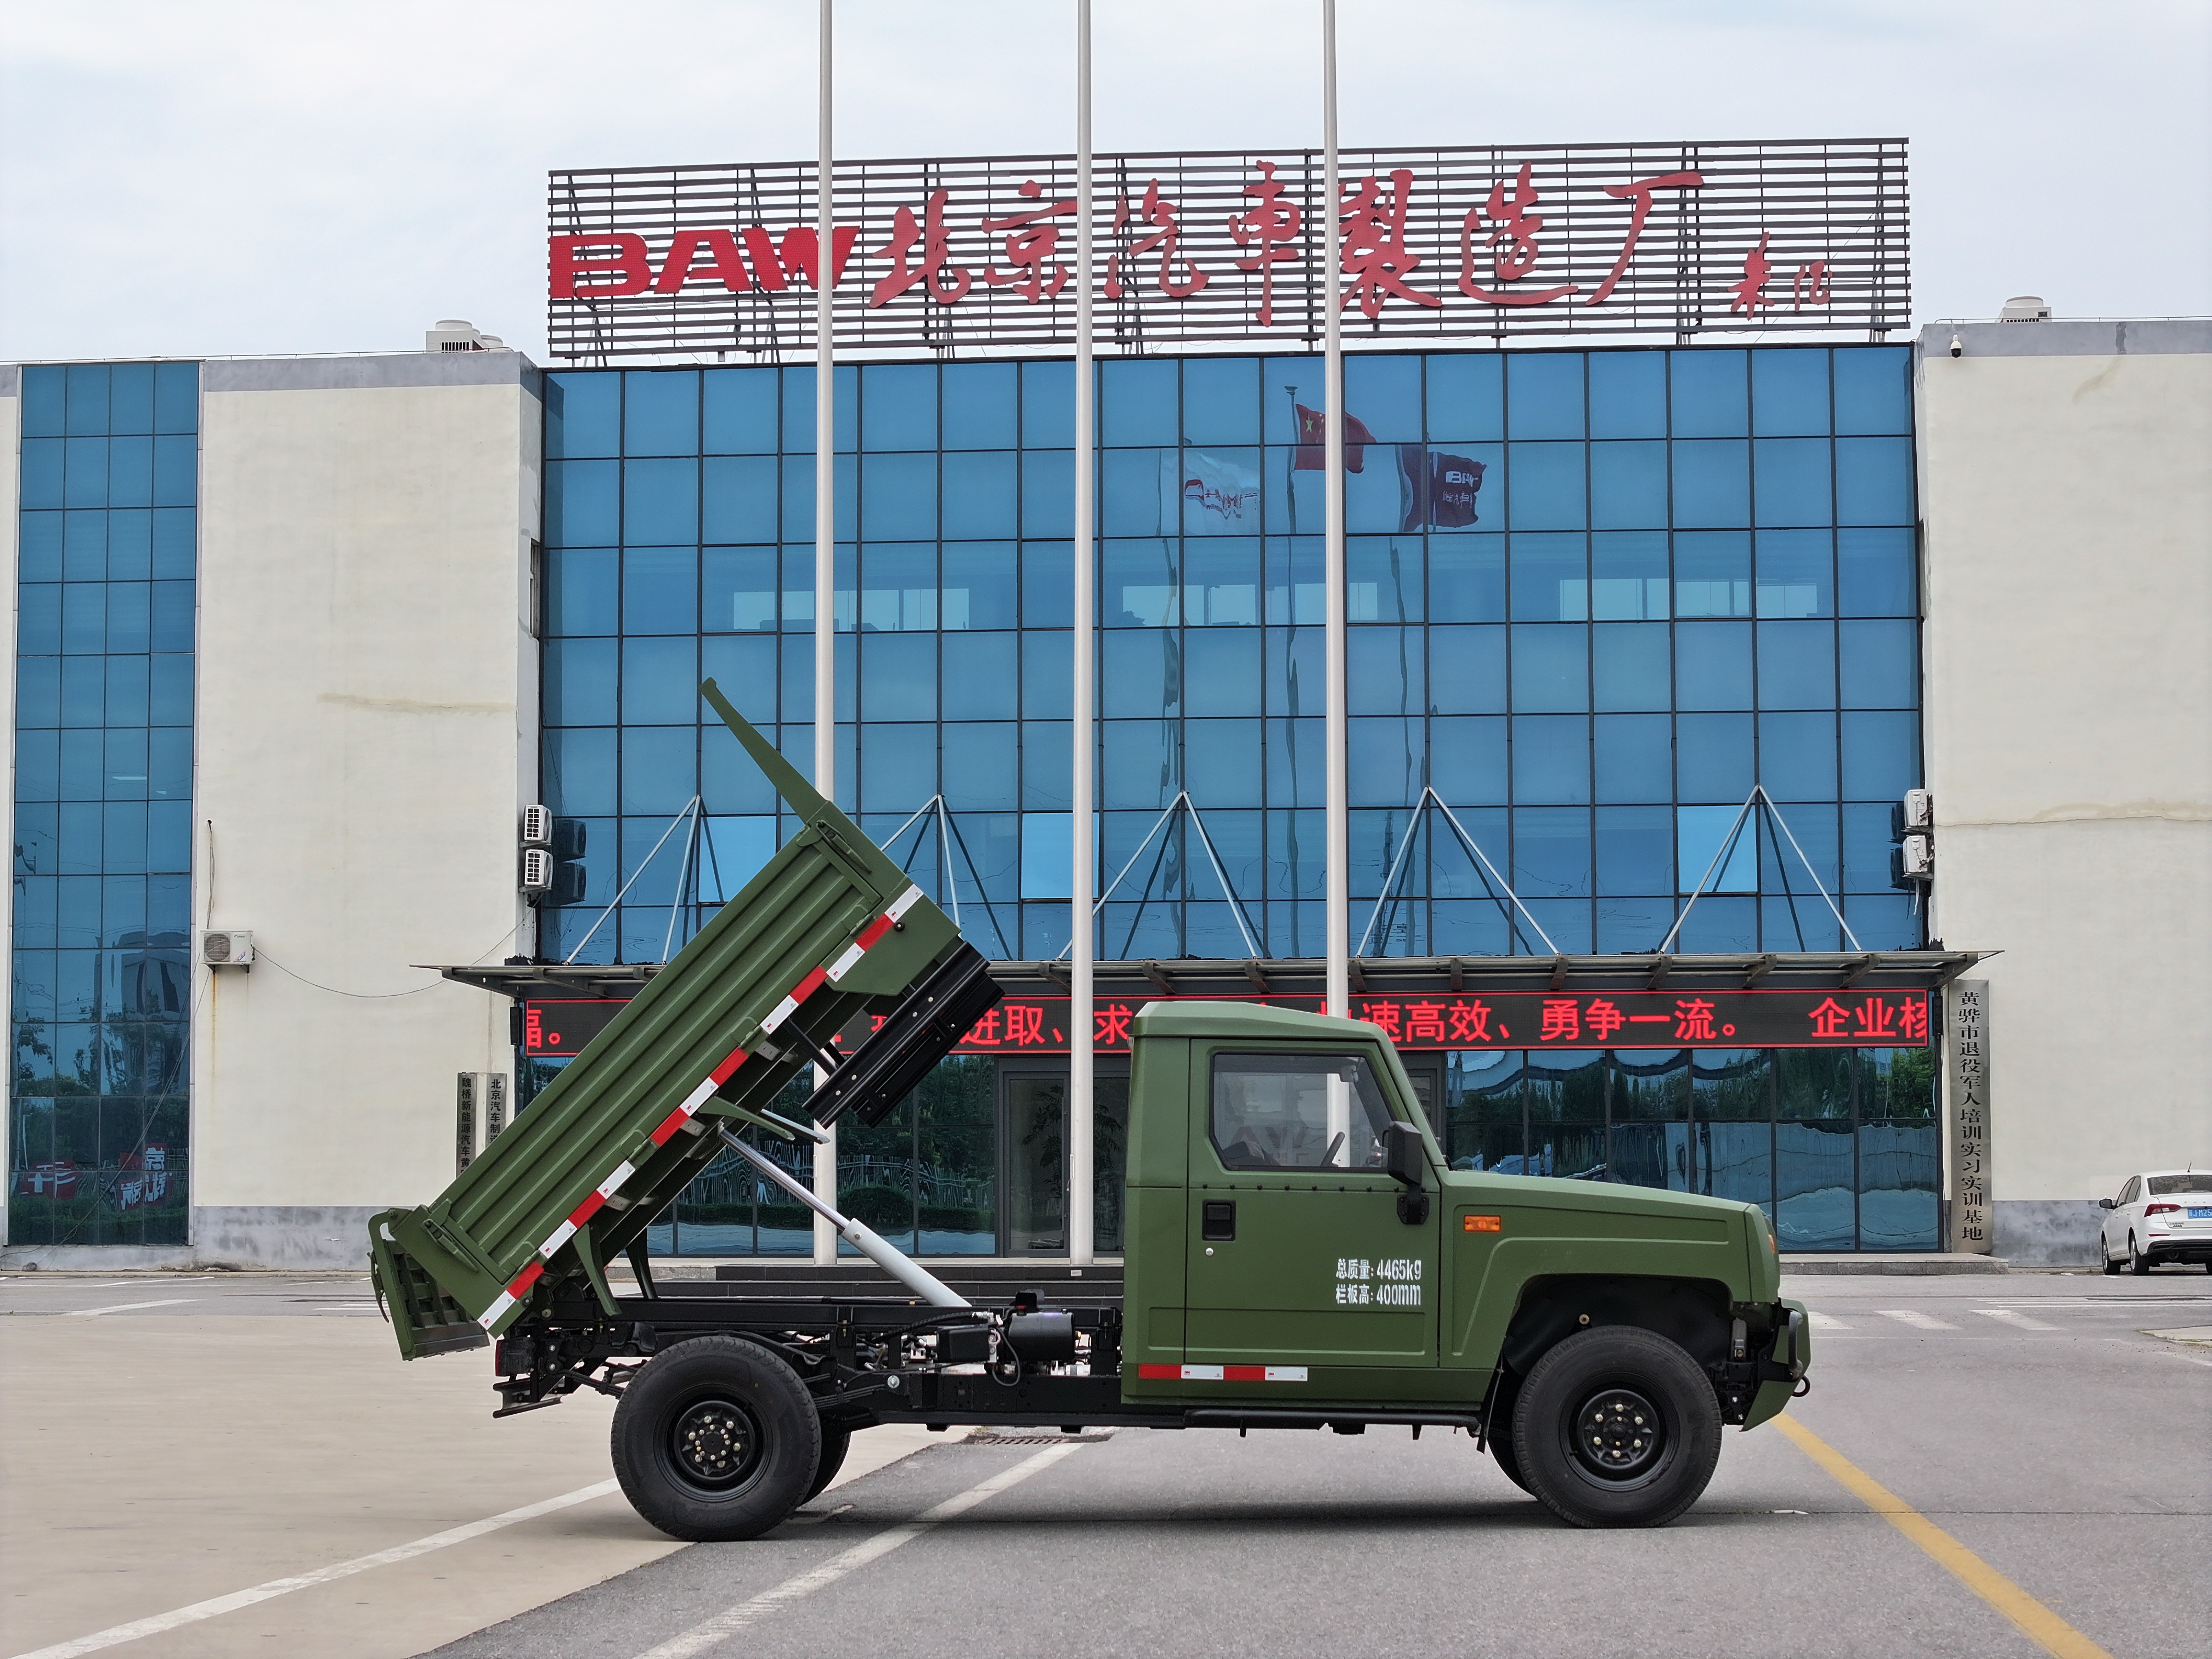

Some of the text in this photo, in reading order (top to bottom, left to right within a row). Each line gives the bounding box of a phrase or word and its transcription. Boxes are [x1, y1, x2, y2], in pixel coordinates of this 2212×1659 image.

[548, 226, 860, 299] BAW
[461, 1077, 471, 1173] 魏桥新能源汽车黄
[1958, 991, 1983, 1241] 黄骅市退役军人培训实习实训基地
[1335, 1284, 1421, 1306] 栏板高：400mm
[1336, 1258, 1421, 1280] 总质量：4465kg
